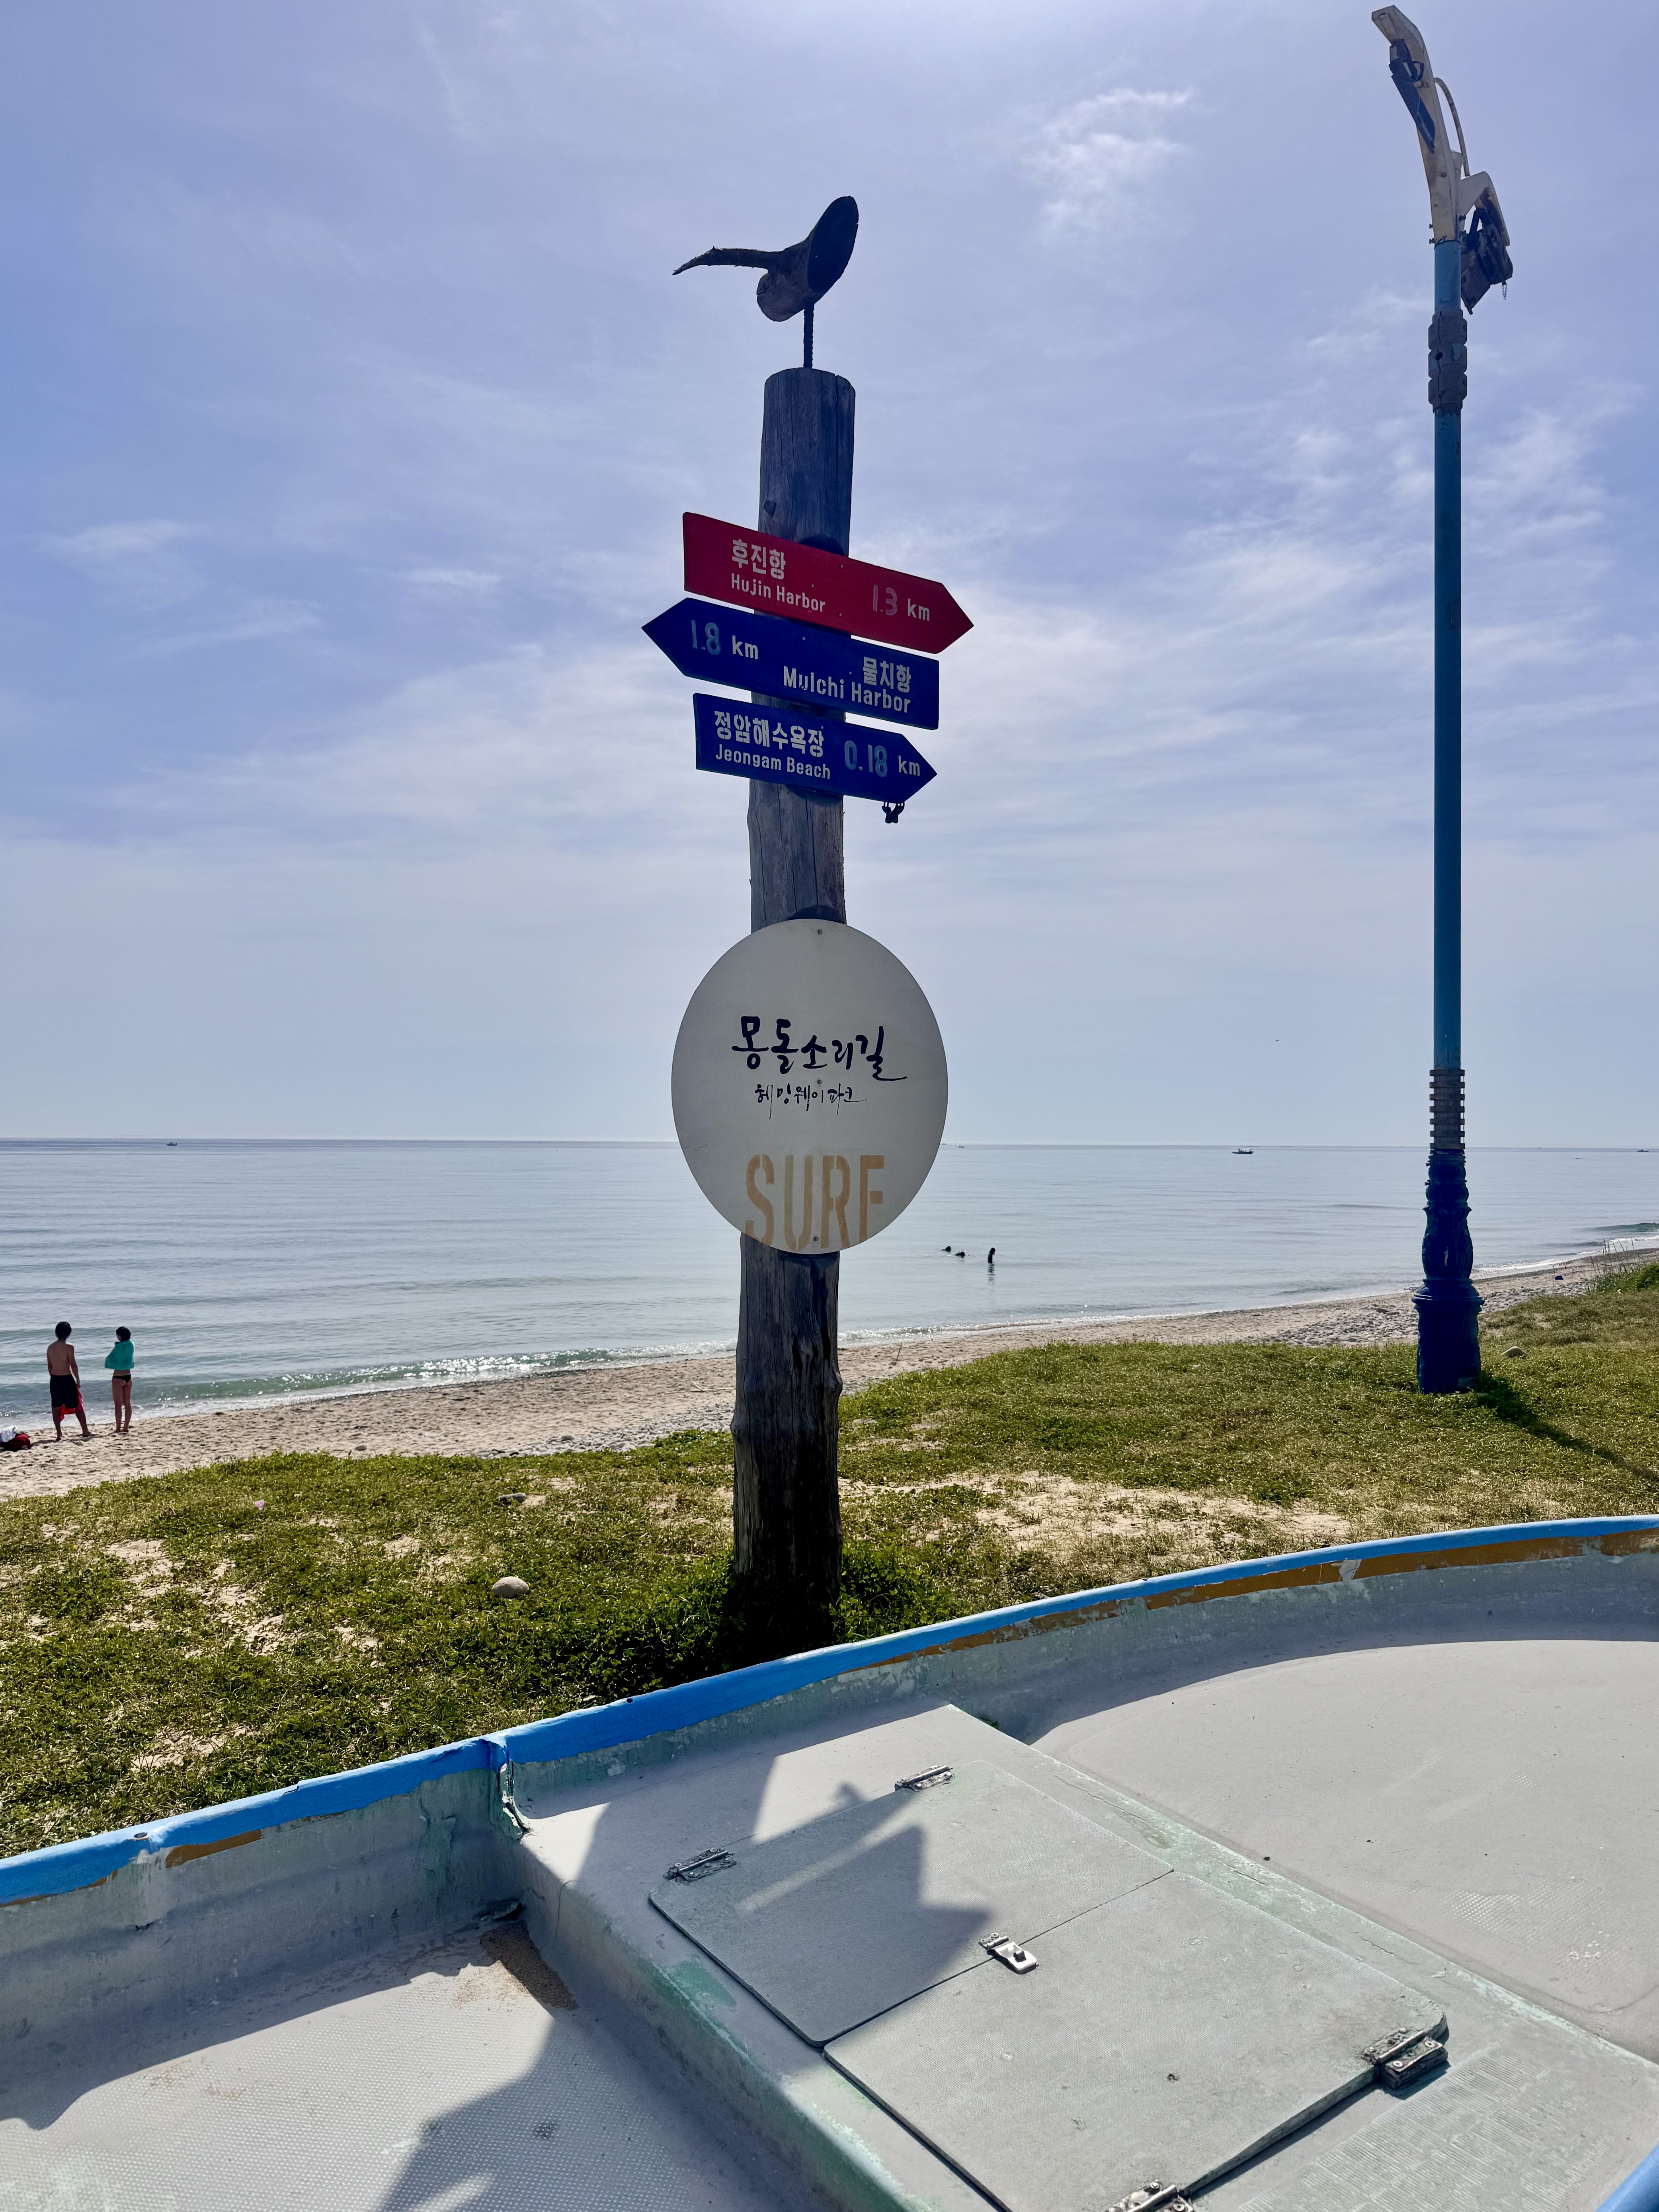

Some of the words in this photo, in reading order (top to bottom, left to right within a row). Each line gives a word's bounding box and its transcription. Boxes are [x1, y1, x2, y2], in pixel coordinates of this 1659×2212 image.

[732, 539, 786, 579] 후진항
[731, 573, 771, 599] Hujin
[777, 585, 826, 612] Harbor
[873, 584, 897, 616] 1.3
[907, 599, 930, 622] km
[691, 620, 721, 655] 1.8
[732, 635, 758, 659] km
[783, 666, 844, 699] Mulchi
[851, 682, 911, 713] Harbor
[863, 656, 911, 693] 물치항
[714, 711, 824, 757] 정암해수욕장
[716, 744, 781, 771] Jeongam
[787, 757, 830, 780] Beach
[844, 740, 888, 777] 0.18
[898, 756, 920, 776] km
[732, 1016, 908, 1081] 몽돌소리길
[745, 1154, 884, 1252] SURF
